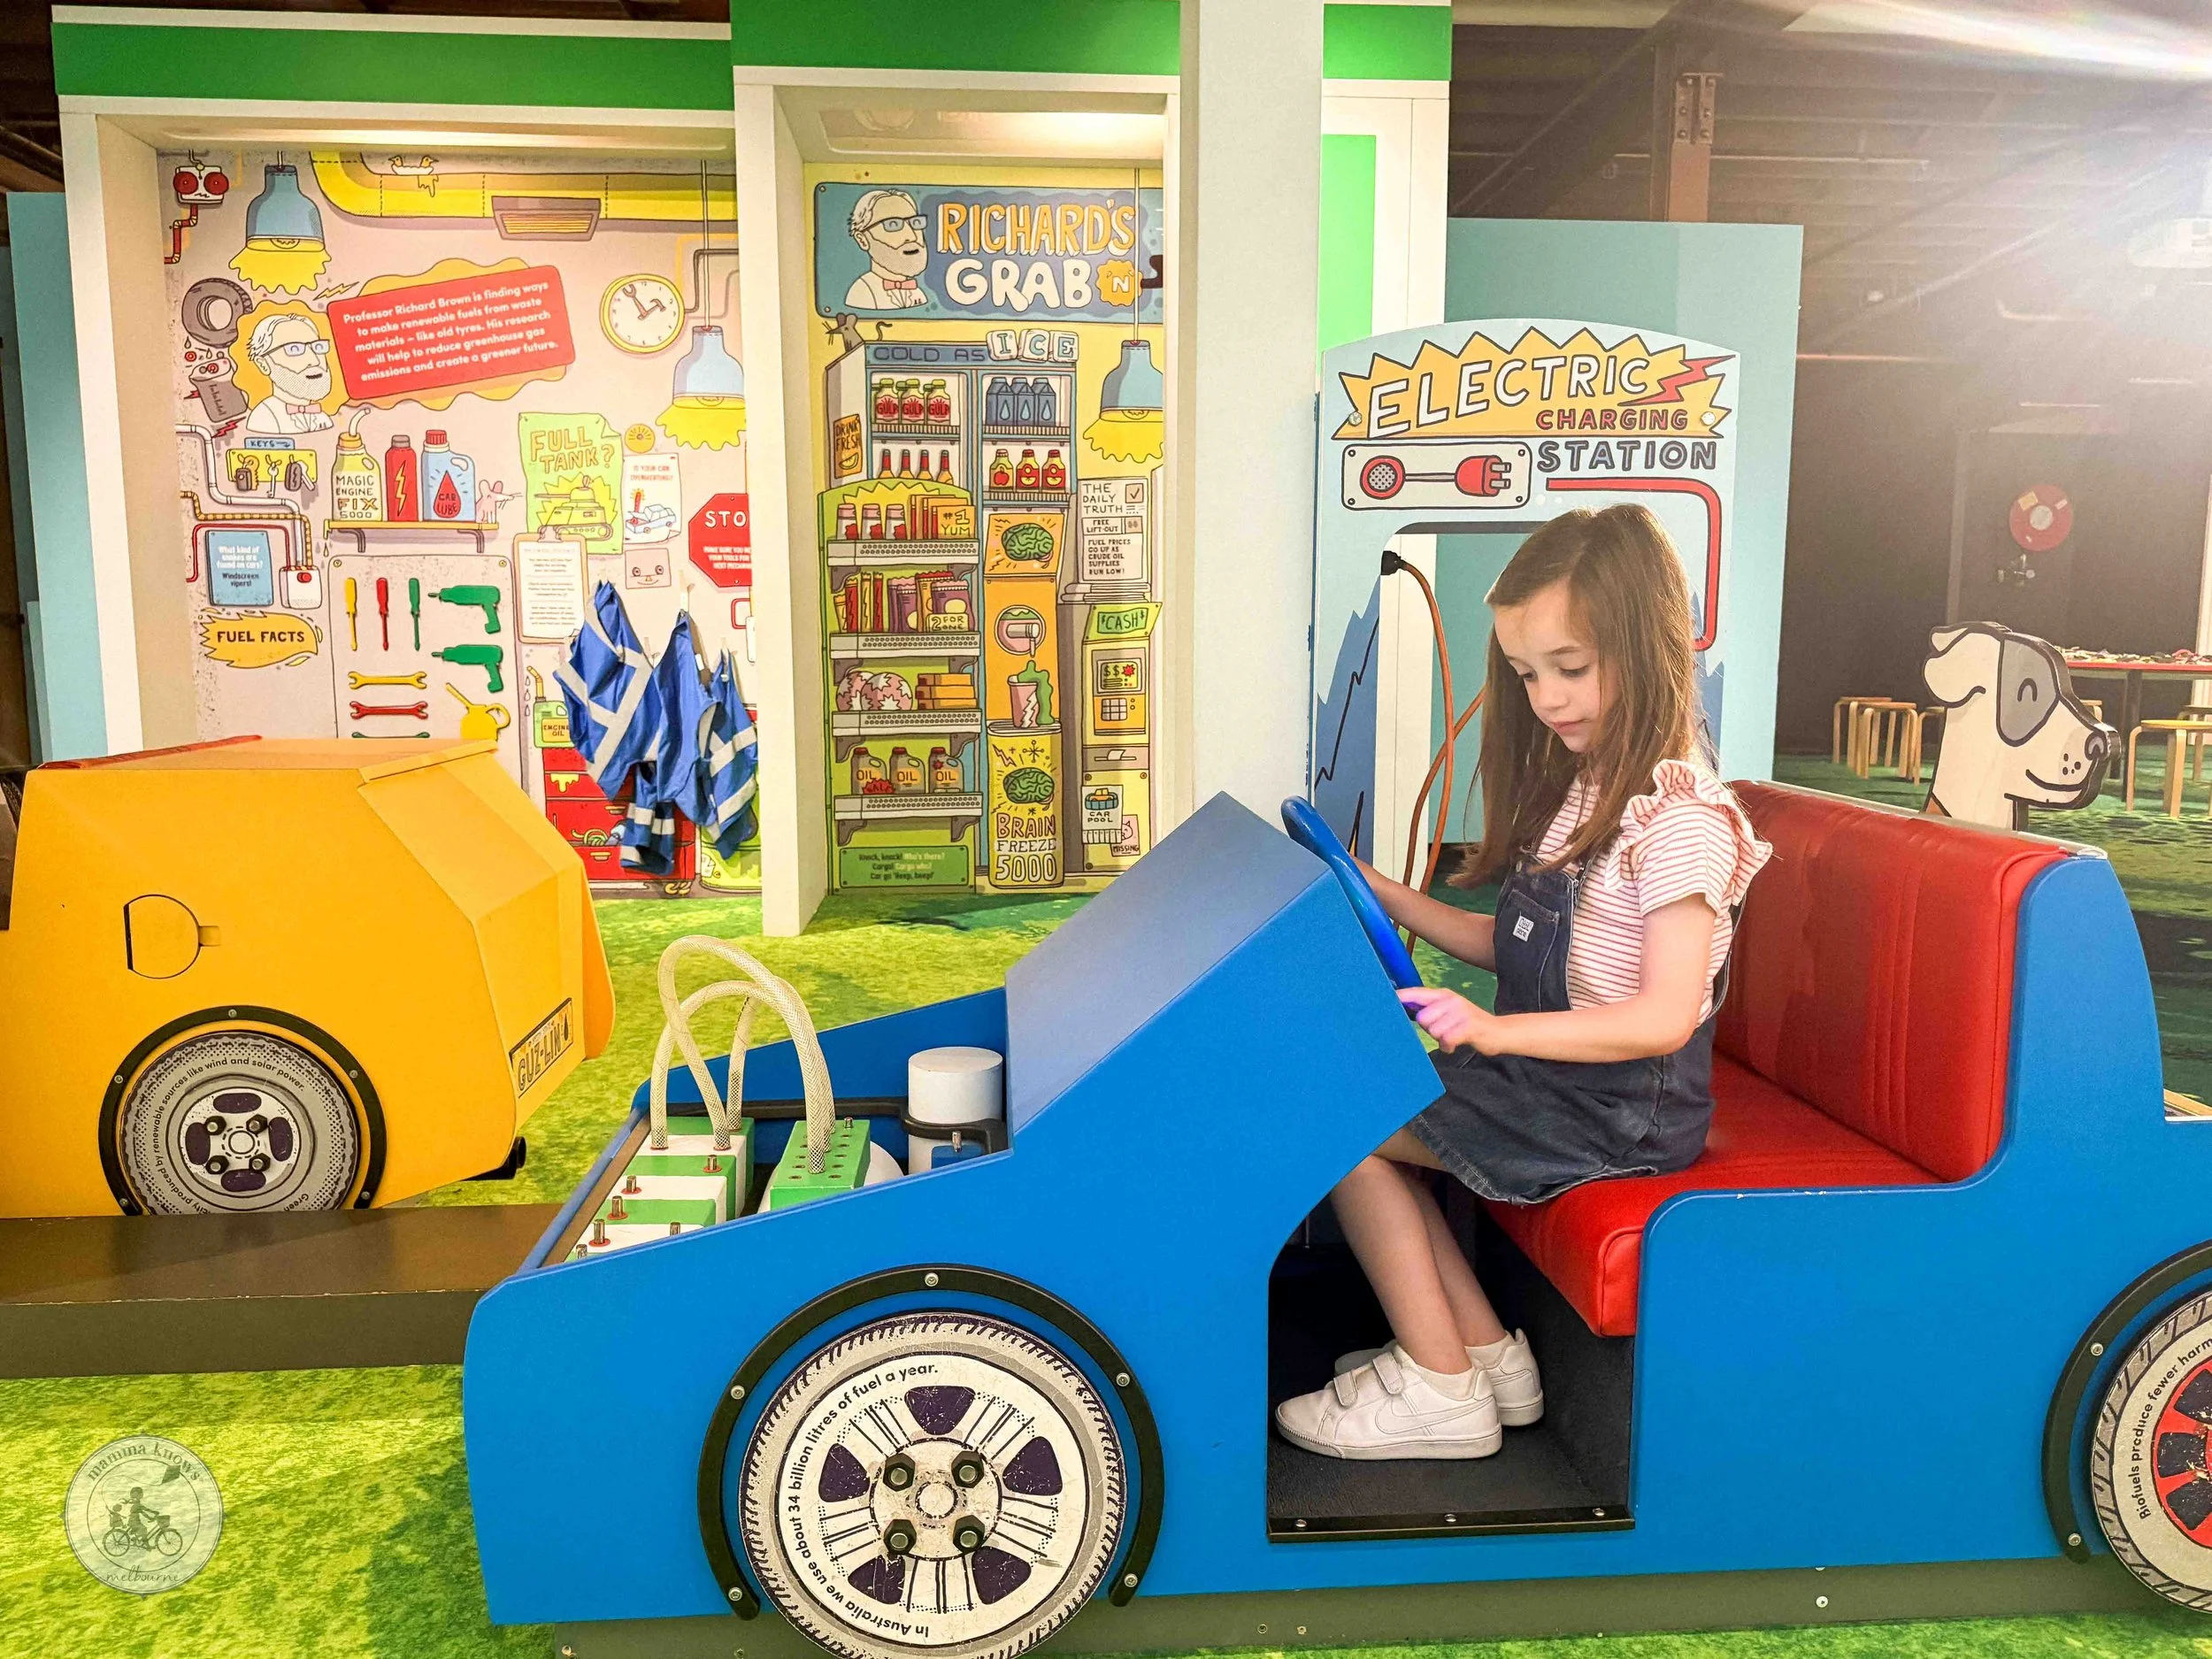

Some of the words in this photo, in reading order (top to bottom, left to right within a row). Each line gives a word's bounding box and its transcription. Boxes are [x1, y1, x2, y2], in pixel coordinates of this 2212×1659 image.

[936, 197, 1136, 257] RICHARD'S
[944, 258, 1093, 312] GRAB
[343, 310, 393, 324] Professor
[395, 299, 436, 315] Richard
[438, 296, 472, 308] Brown
[472, 291, 482, 302] is
[483, 287, 520, 300] finding
[522, 282, 549, 294] ways
[357, 327, 368, 336] to
[371, 322, 398, 334] make
[401, 312, 456, 329] renewable
[457, 307, 482, 319] fuels
[484, 304, 510, 315] from
[511, 297, 542, 310] waste
[355, 335, 404, 352] materials
[416, 330, 434, 342] like
[436, 326, 454, 338] old
[456, 324, 485, 337] tyres.
[486, 318, 503, 329] His
[505, 310, 551, 326] research
[367, 352, 386, 365] will
[387, 349, 411, 362] help
[412, 348, 423, 357] to
[426, 342, 461, 355] reduce
[464, 331, 524, 351] greenhouse
[526, 327, 546, 341] gas
[874, 346, 941, 363] COLD
[954, 347, 986, 362] AS
[996, 332, 1075, 358] ICE
[361, 365, 411, 381] emissions
[413, 360, 434, 372] and
[435, 356, 469, 368] create
[480, 346, 521, 363] greener
[523, 341, 558, 353] future.
[1367, 353, 1651, 440] ELECTRIC
[876, 402, 899, 415] GULP
[902, 402, 925, 415] GULP
[928, 402, 950, 415] GULP
[1536, 408, 1689, 432] CHARGING
[530, 426, 594, 462] FULL
[1537, 440, 1717, 472] STATION
[335, 474, 374, 487] MAGIC
[1082, 483, 1111, 494] THE
[338, 497, 379, 511] FIX
[436, 502, 458, 515] LUBE
[1082, 494, 1117, 503] DAILY
[704, 510, 748, 528] STO
[1083, 504, 1123, 514] TRUTH
[941, 524, 971, 536] YUM
[217, 560, 235, 569] found
[931, 616, 941, 631] 2
[217, 630, 255, 643] FUEL
[260, 630, 305, 643] FACTS
[856, 770, 877, 781] OIL
[896, 771, 918, 782] OIL
[935, 771, 956, 782] OIL
[996, 813, 1056, 839] BRAIN
[996, 838, 1056, 852] FREEZE
[1112, 844, 1140, 853] MISSING
[995, 854, 1057, 882] 5000
[204, 1056, 227, 1070] wind
[252, 1060, 277, 1071] solar
[518, 1023, 562, 1092] GUZ-LIN
[187, 1066, 204, 1078] like
[276, 1069, 305, 1092] power.
[162, 1076, 188, 1105] sources
[152, 1106, 165, 1154] renewable
[155, 1155, 164, 1166] by
[159, 1168, 192, 1204] produced
[283, 1194, 310, 1212] Green
[2177, 1337, 2212, 1364] harm
[885, 1371, 896, 1382] a
[898, 1363, 939, 1383] year.
[2147, 1363, 2178, 1401] fewer
[852, 1373, 882, 1399] fuel
[838, 1391, 853, 1410] of
[805, 1409, 838, 1446] litres
[2131, 1403, 2154, 1462] produce
[788, 1447, 813, 1490] billion
[2128, 1464, 2152, 1520] Biofuels
[787, 1494, 801, 1512] 34
[789, 1515, 811, 1560] about
[807, 1560, 828, 1586] use
[826, 1585, 844, 1603] we
[844, 1601, 911, 1637] Australia
[915, 1624, 930, 1638] In
